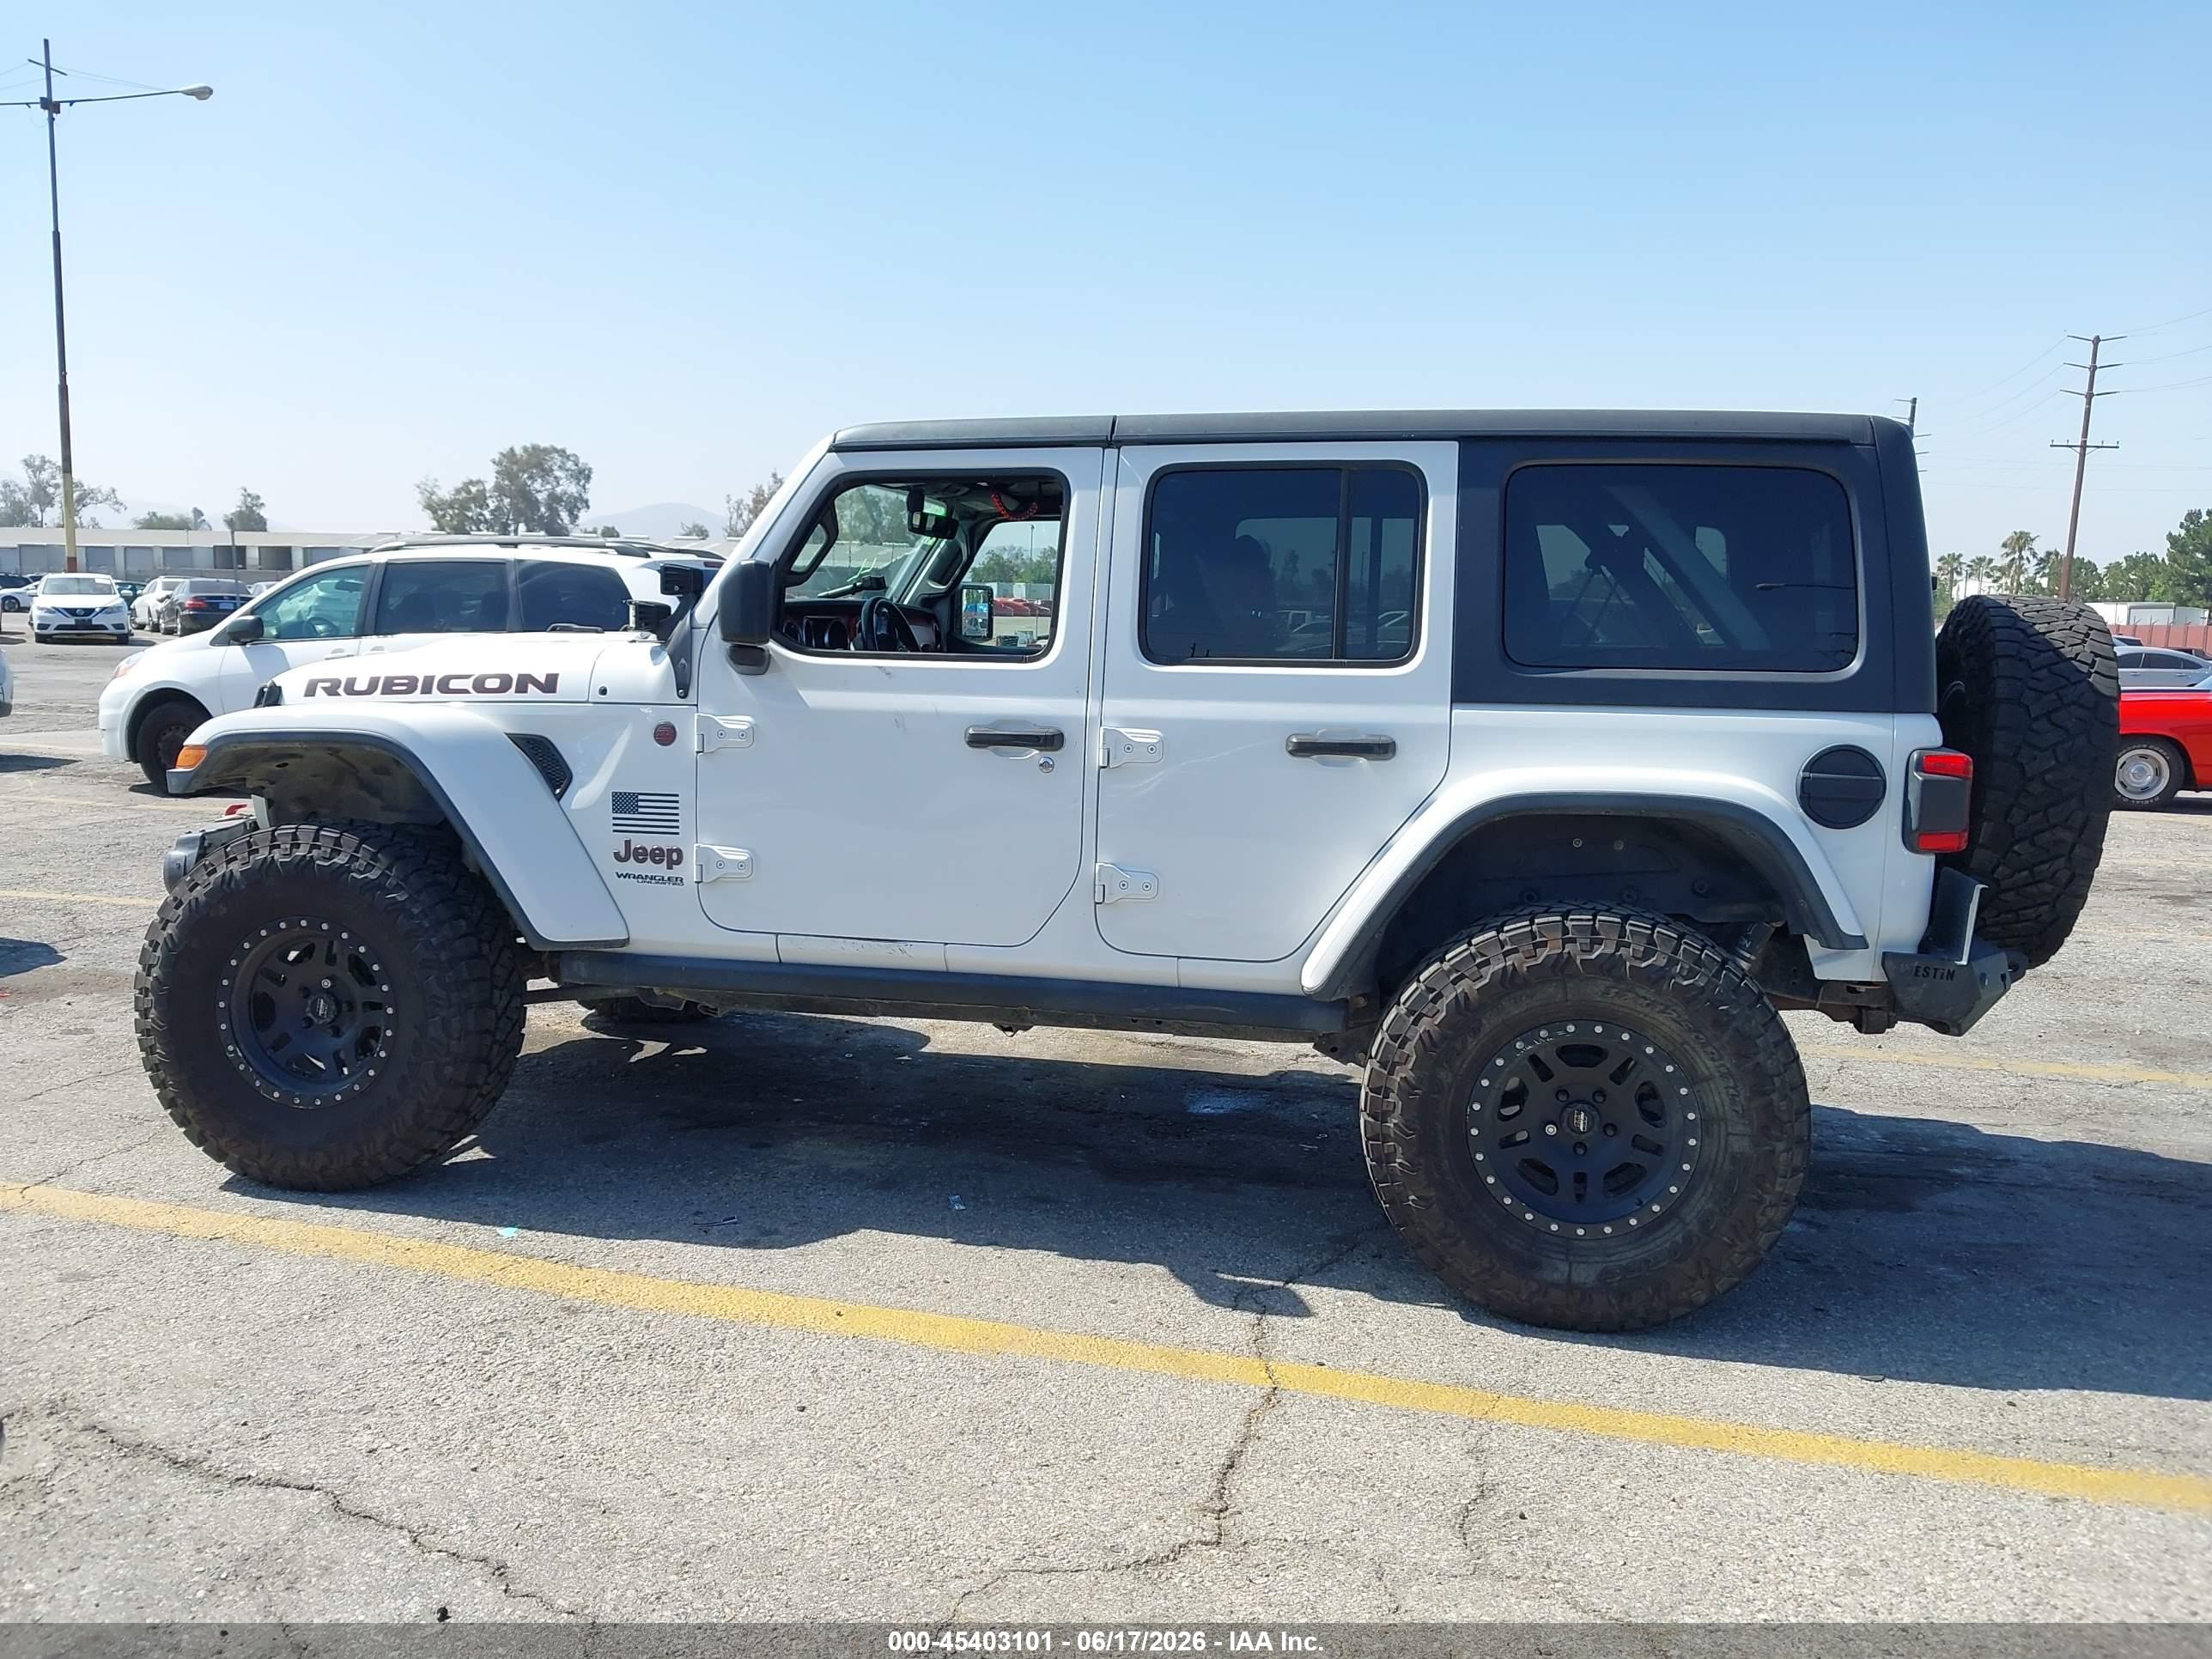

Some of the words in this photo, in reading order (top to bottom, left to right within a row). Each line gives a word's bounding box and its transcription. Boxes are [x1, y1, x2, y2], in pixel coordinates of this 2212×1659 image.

[303, 673, 560, 697] RUBICON
[612, 838, 684, 871] Jeep
[615, 872, 684, 883] WRANGLER
